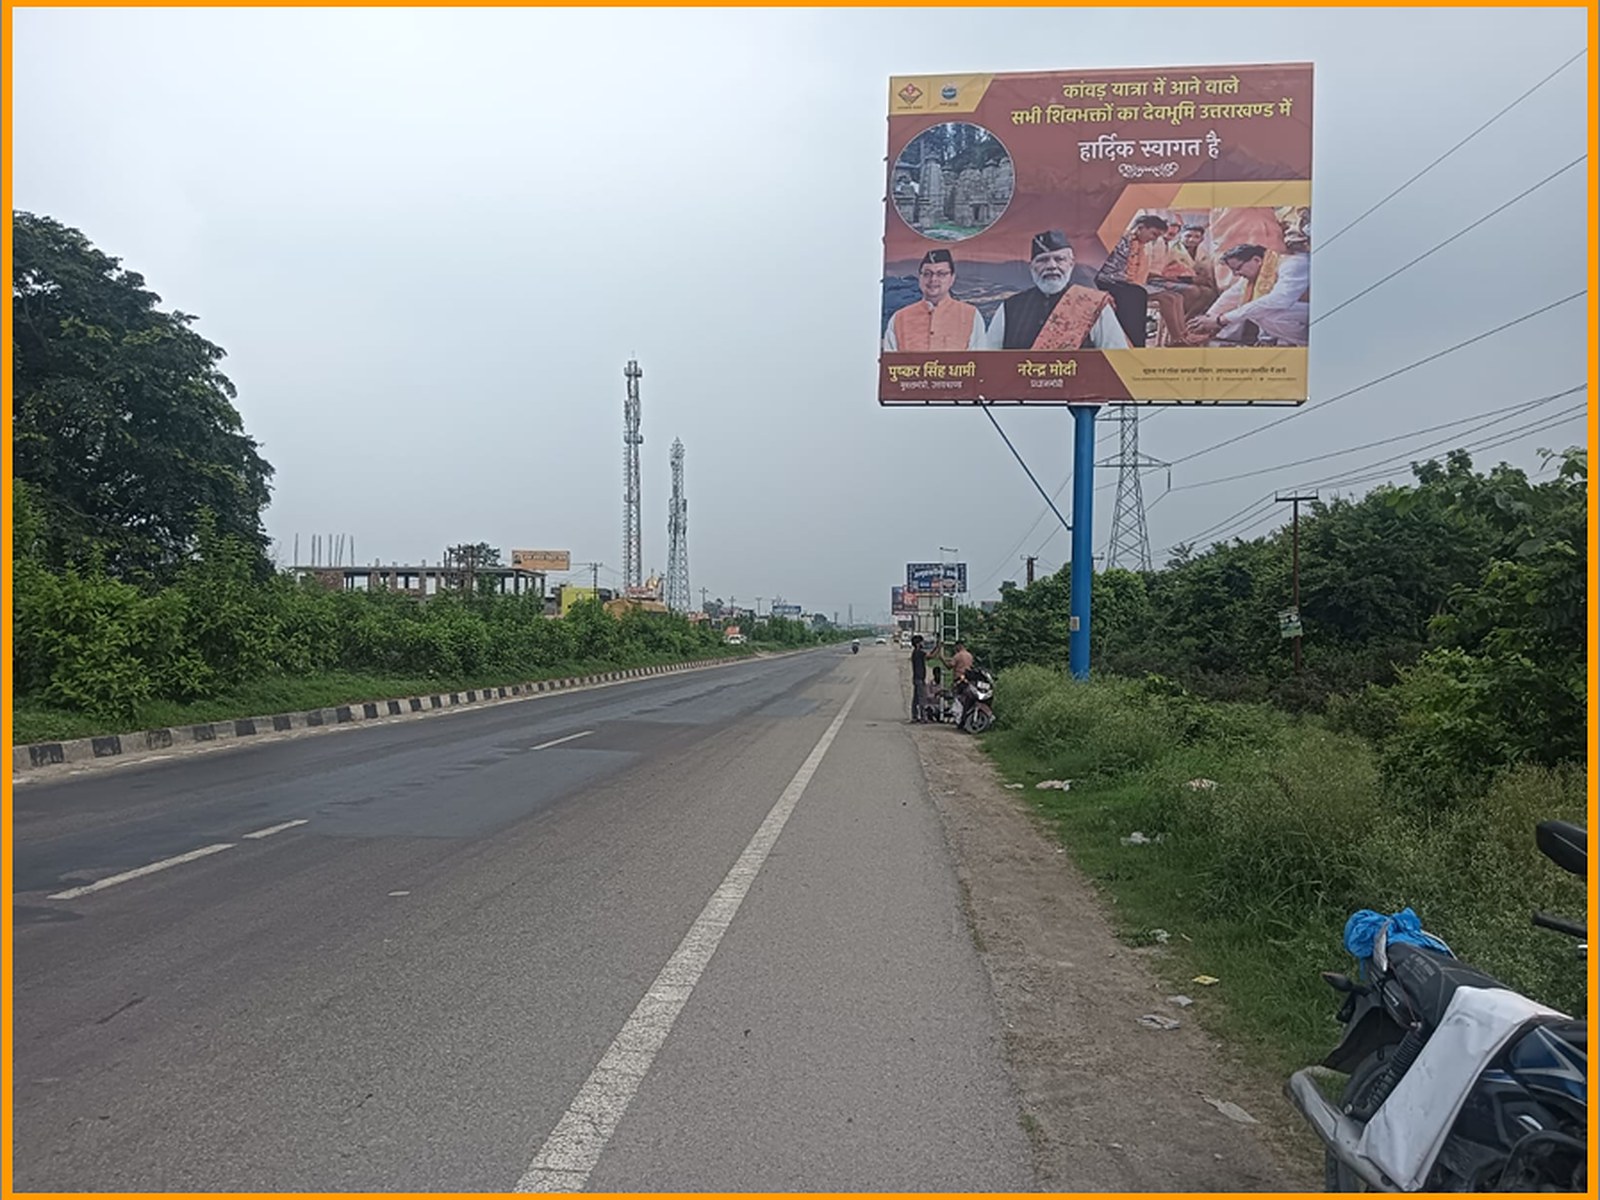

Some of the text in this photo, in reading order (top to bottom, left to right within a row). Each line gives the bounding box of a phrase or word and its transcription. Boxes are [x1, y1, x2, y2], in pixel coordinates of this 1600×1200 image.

[1063, 75, 1240, 100] कांवड़ यात्रा में आने वाले
[1011, 98, 1292, 125] सभी शिवभक्तों का देवभूमि उत्तराखण्ड में
[1078, 130, 1221, 161] हार्दिक स्वागत है
[888, 360, 976, 382] पुष्कर सिंह धामी
[1017, 359, 1077, 377] नरेन्द्र मोदी
